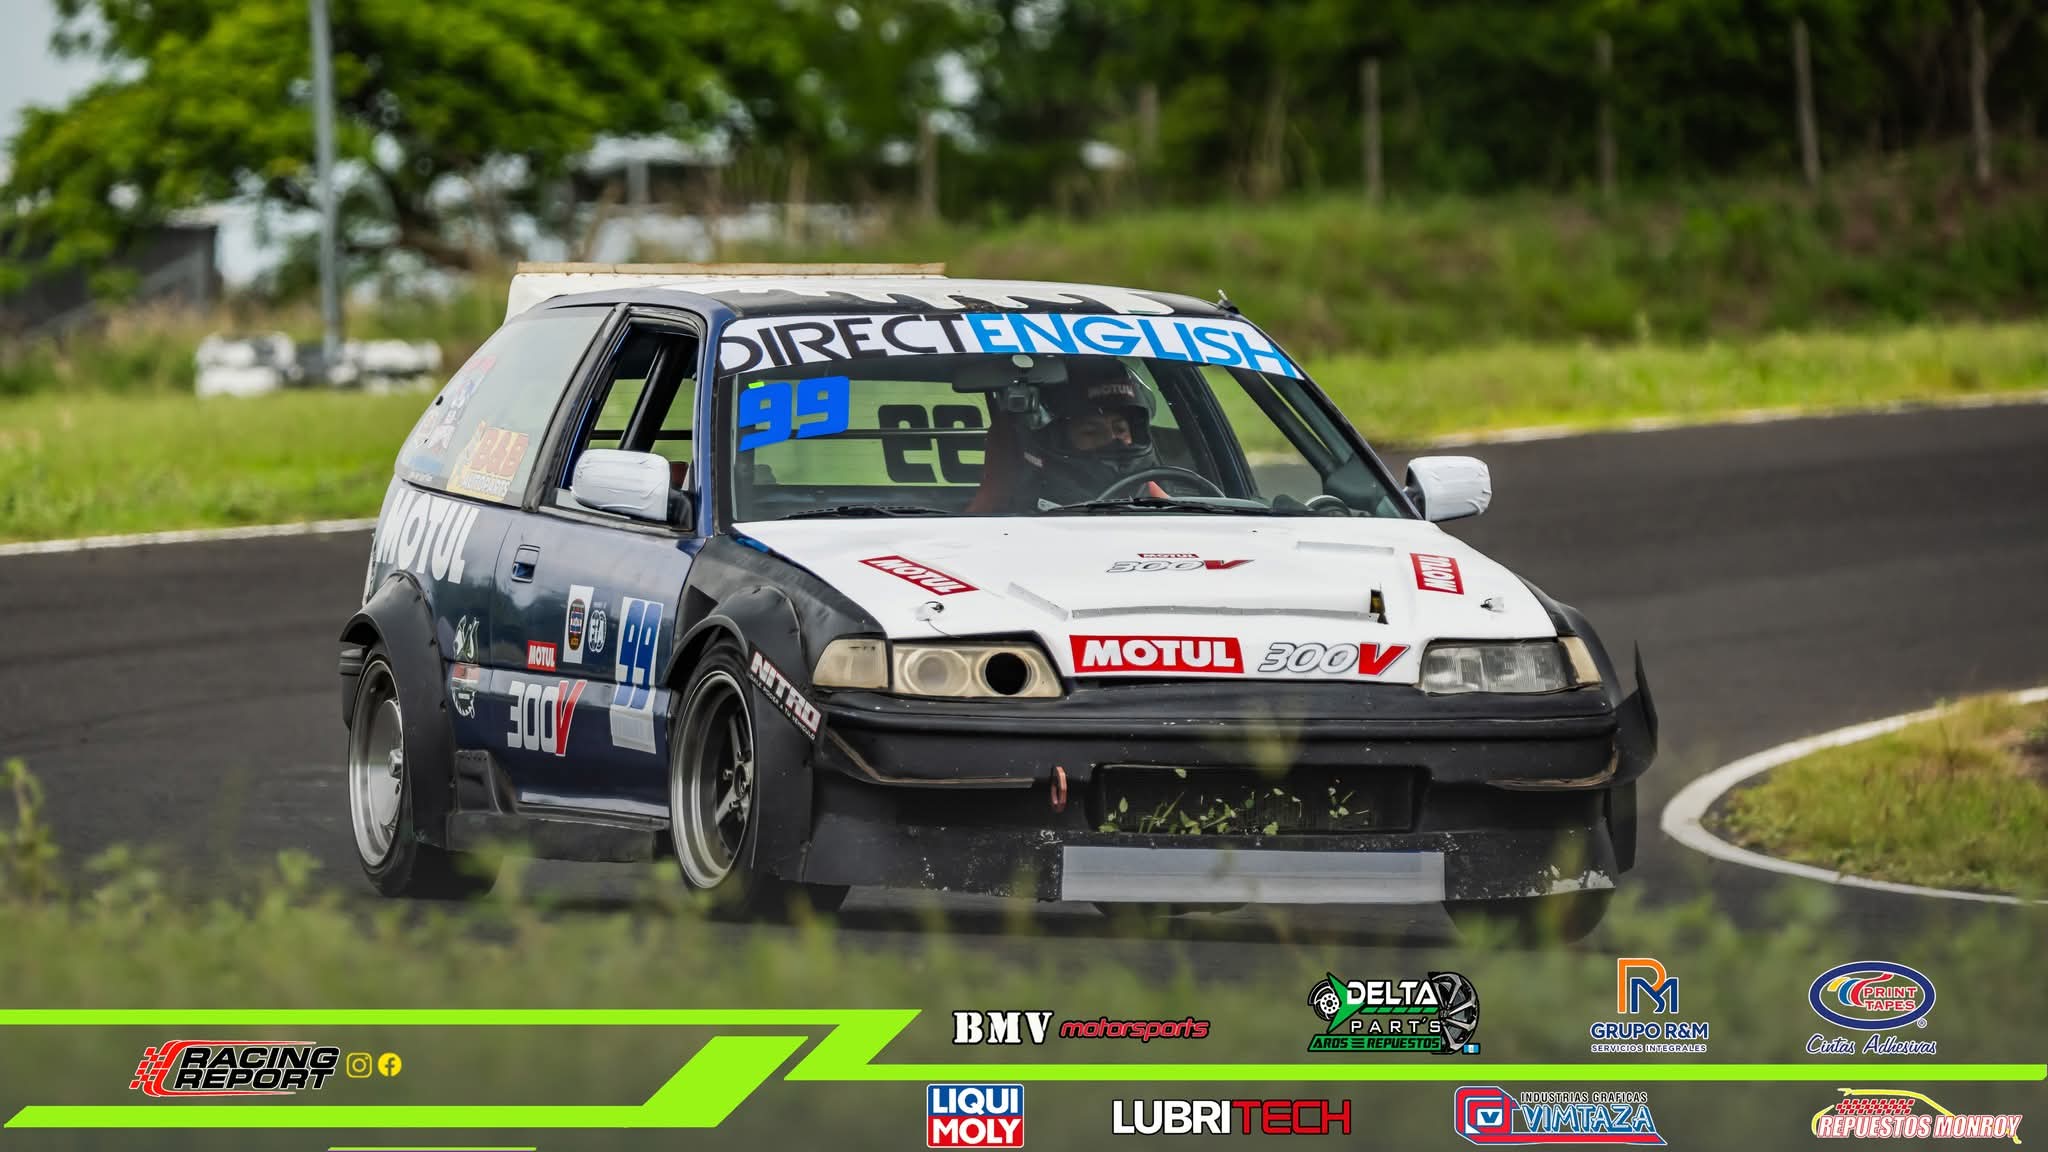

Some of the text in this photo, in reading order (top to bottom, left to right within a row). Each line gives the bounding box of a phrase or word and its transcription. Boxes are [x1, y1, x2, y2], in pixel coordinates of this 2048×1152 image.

[739, 376, 849, 451] 99
[376, 488, 480, 584] MOTUL
[867, 559, 968, 593] MOTUL
[1106, 559, 1255, 573] 300V
[1419, 556, 1458, 592] MOTUL
[528, 645, 556, 668] MOTUL
[613, 600, 664, 711] 99
[1082, 640, 1410, 676] MOTUL 300V
[507, 680, 588, 757] 300V
[750, 651, 822, 733] NITRO
